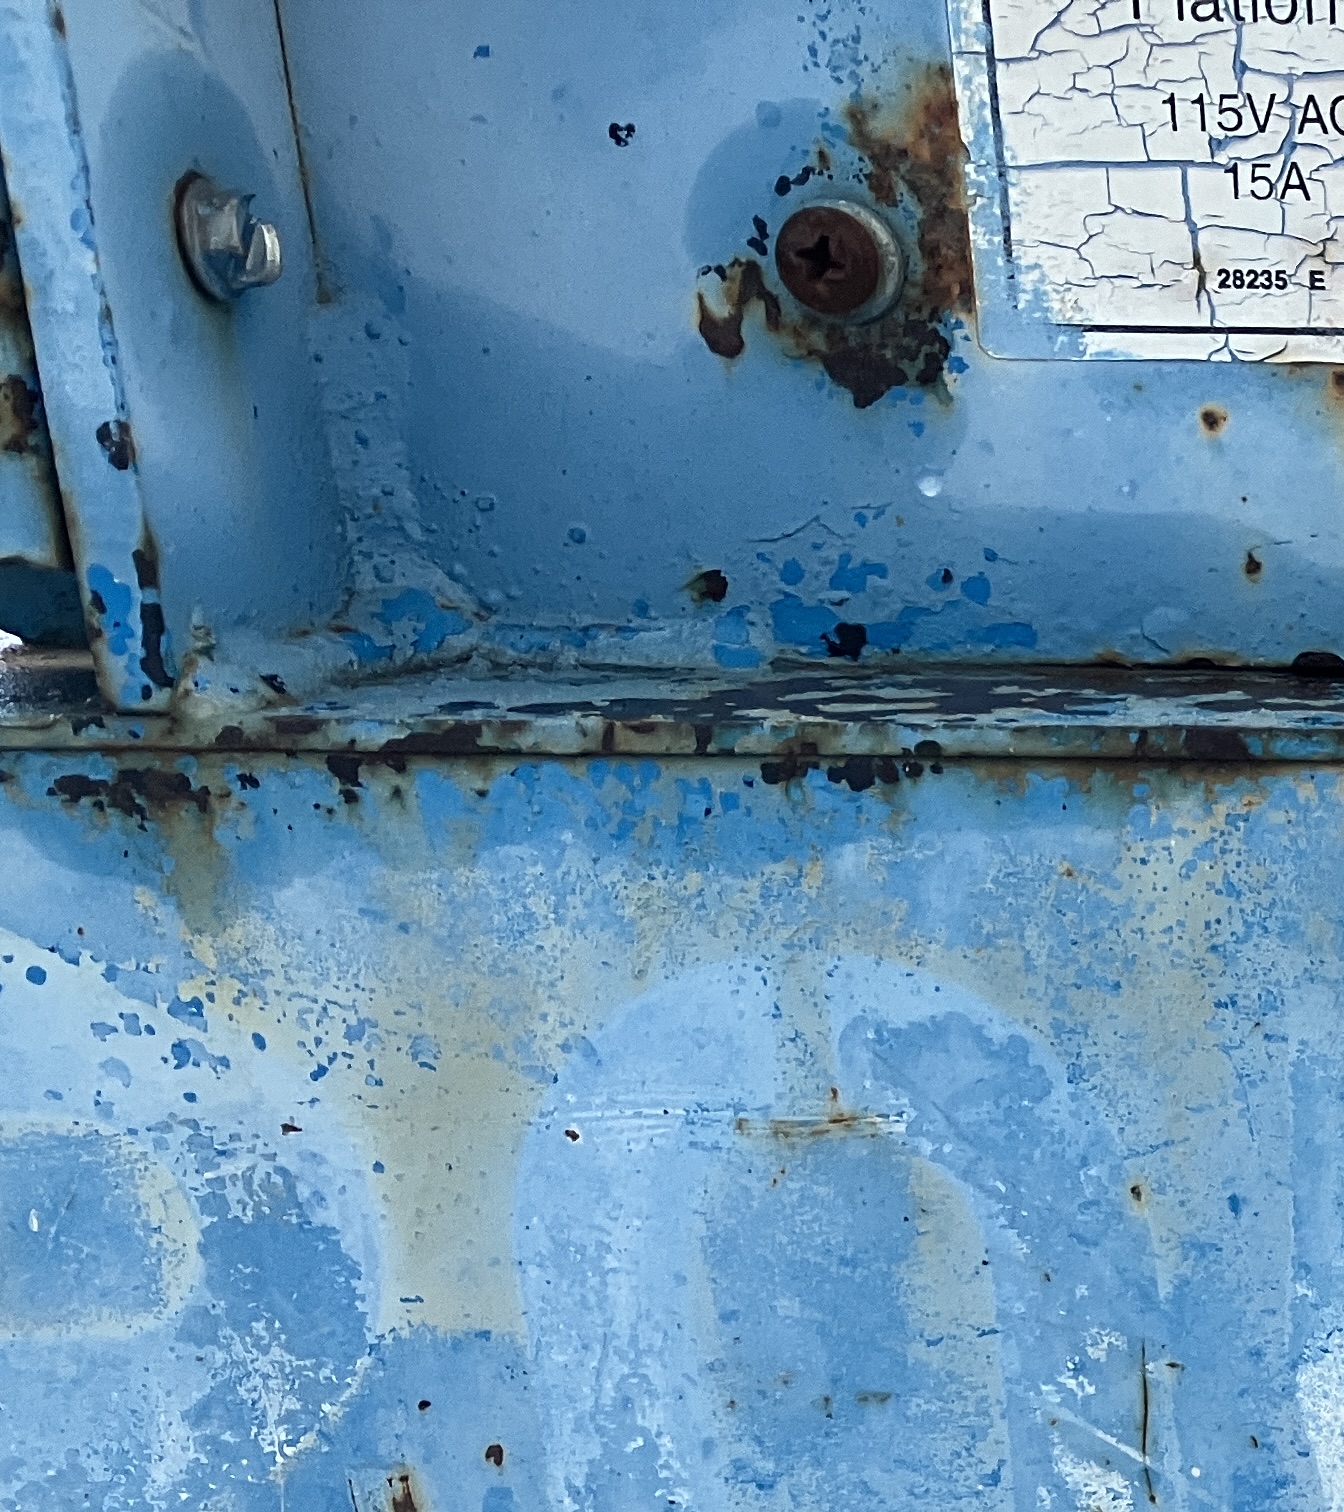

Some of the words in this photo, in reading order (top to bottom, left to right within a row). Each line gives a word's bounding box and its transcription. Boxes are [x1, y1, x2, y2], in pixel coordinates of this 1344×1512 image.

[1162, 92, 1276, 133] 115V
[1224, 162, 1310, 200] 15A
[1218, 269, 1287, 290] 28235
[1308, 270, 1326, 290] E
